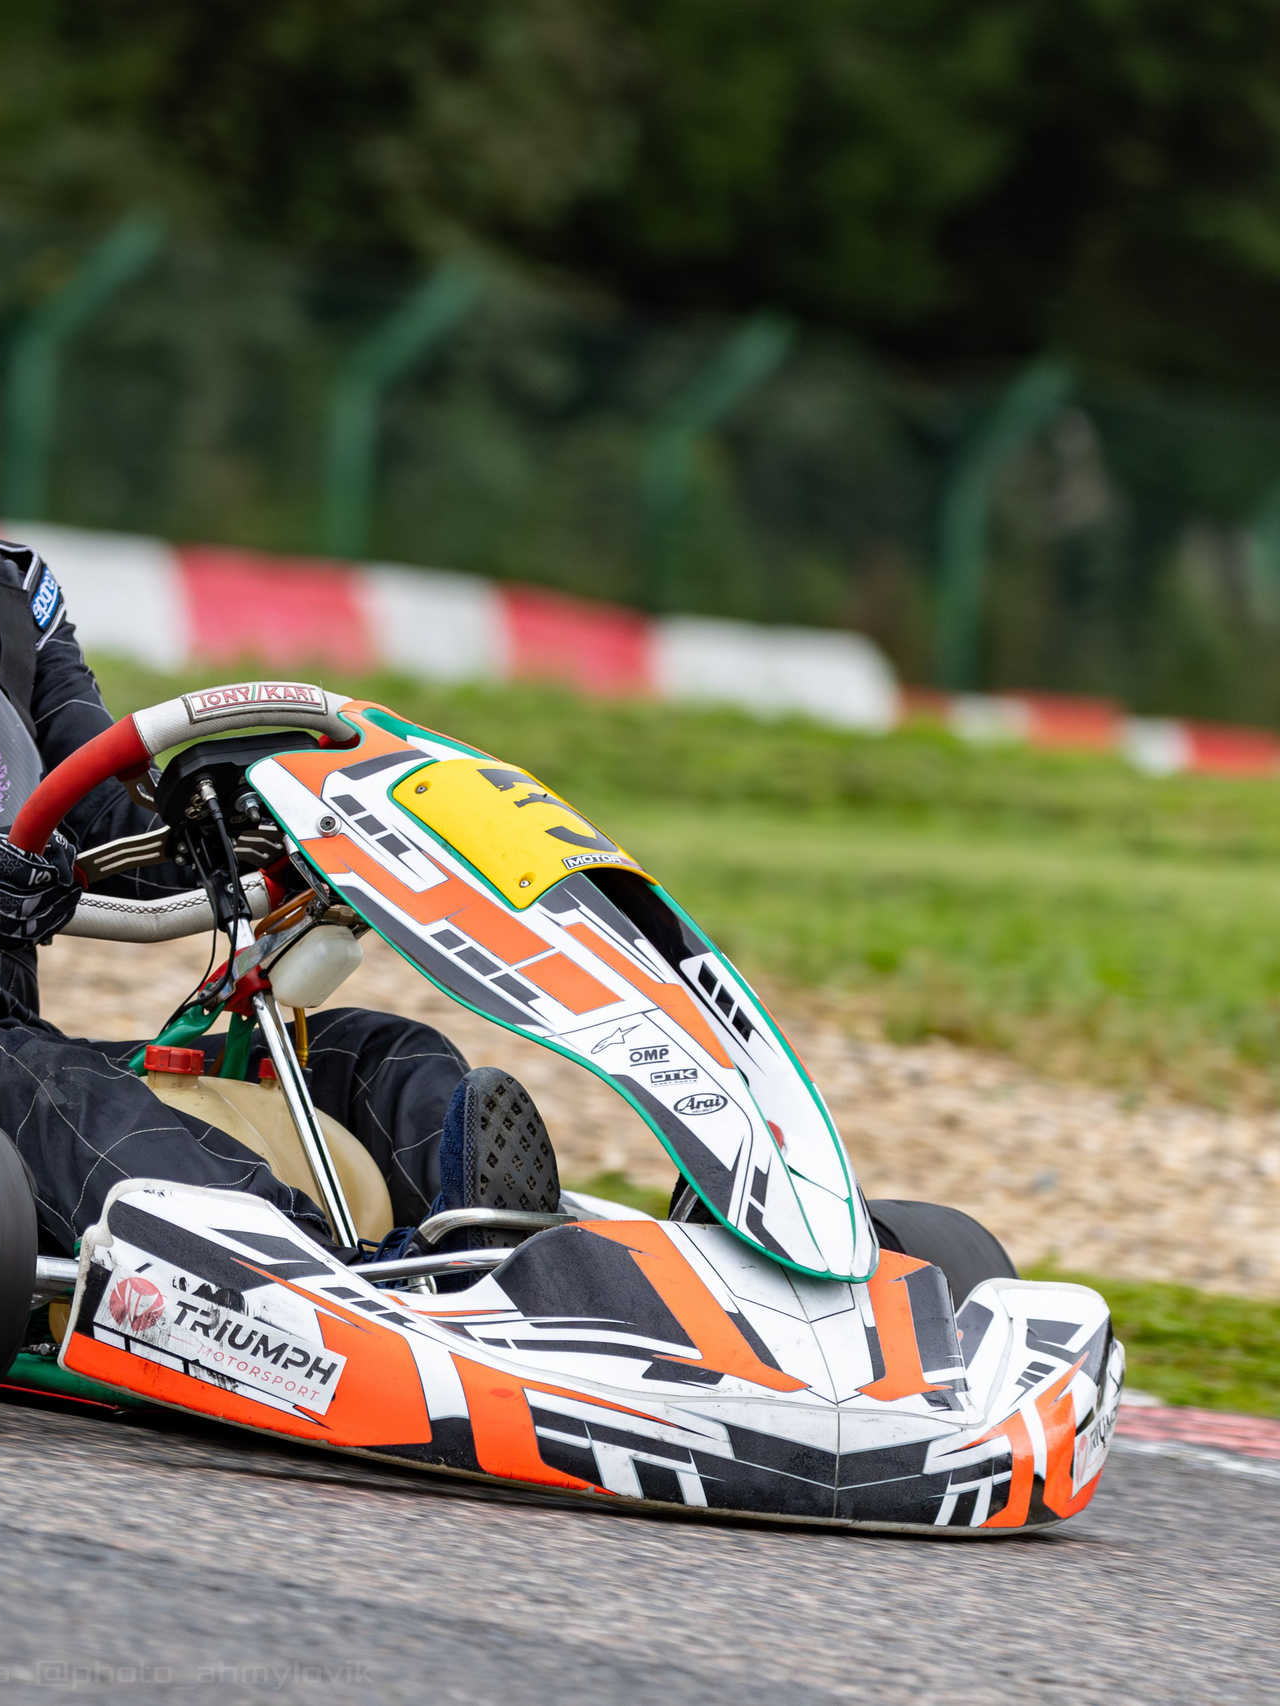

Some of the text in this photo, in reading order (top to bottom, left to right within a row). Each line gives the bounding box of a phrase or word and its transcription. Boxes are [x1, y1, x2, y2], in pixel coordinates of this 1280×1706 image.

[191, 685, 317, 708] TONY KART
[629, 1048, 670, 1063] OMP
[651, 1070, 697, 1082] OTK
[678, 1095, 721, 1111] Arai
[173, 1300, 339, 1386] TRIUMPH
[197, 1344, 321, 1401] MOTORSPORT
